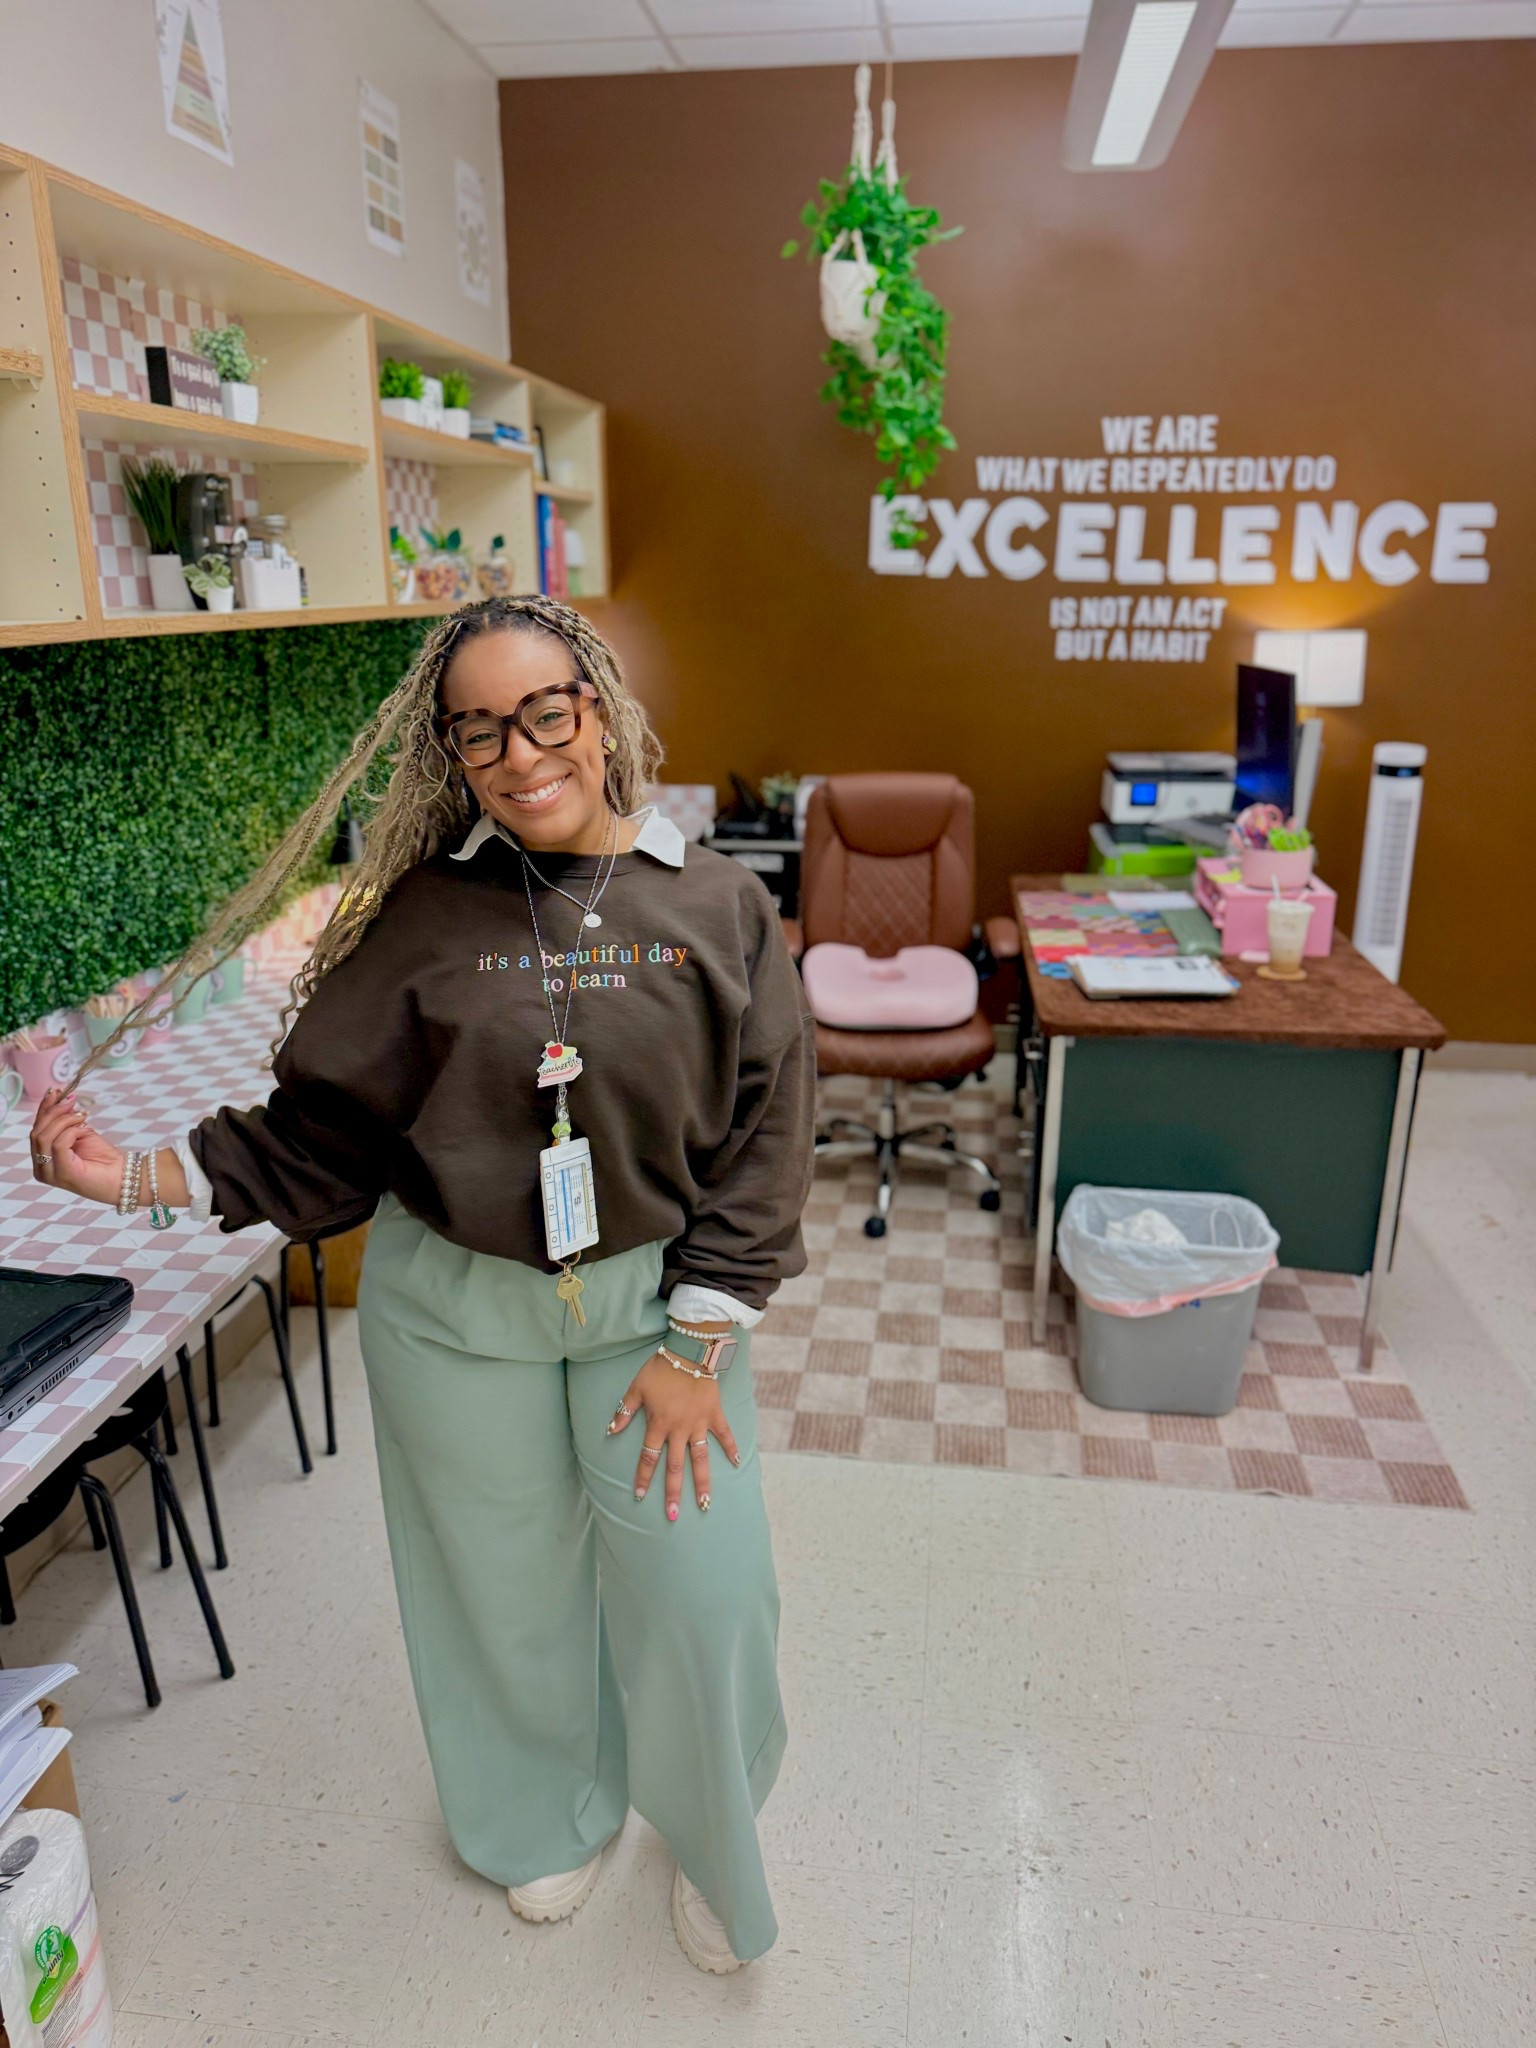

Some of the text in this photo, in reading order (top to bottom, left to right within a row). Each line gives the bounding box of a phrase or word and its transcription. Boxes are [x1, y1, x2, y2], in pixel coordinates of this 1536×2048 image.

[1101, 414, 1219, 453] WE ARE
[975, 455, 1337, 493] WHAT WE REPEATEDLY DO
[868, 494, 1497, 585] EXCELLENCE
[1050, 595, 1228, 630] IS NOT AN ACT
[1054, 629, 1212, 663] BUT A HABIT
[477, 943, 687, 971] it's a beautiful day
[542, 971, 627, 993] to learn
